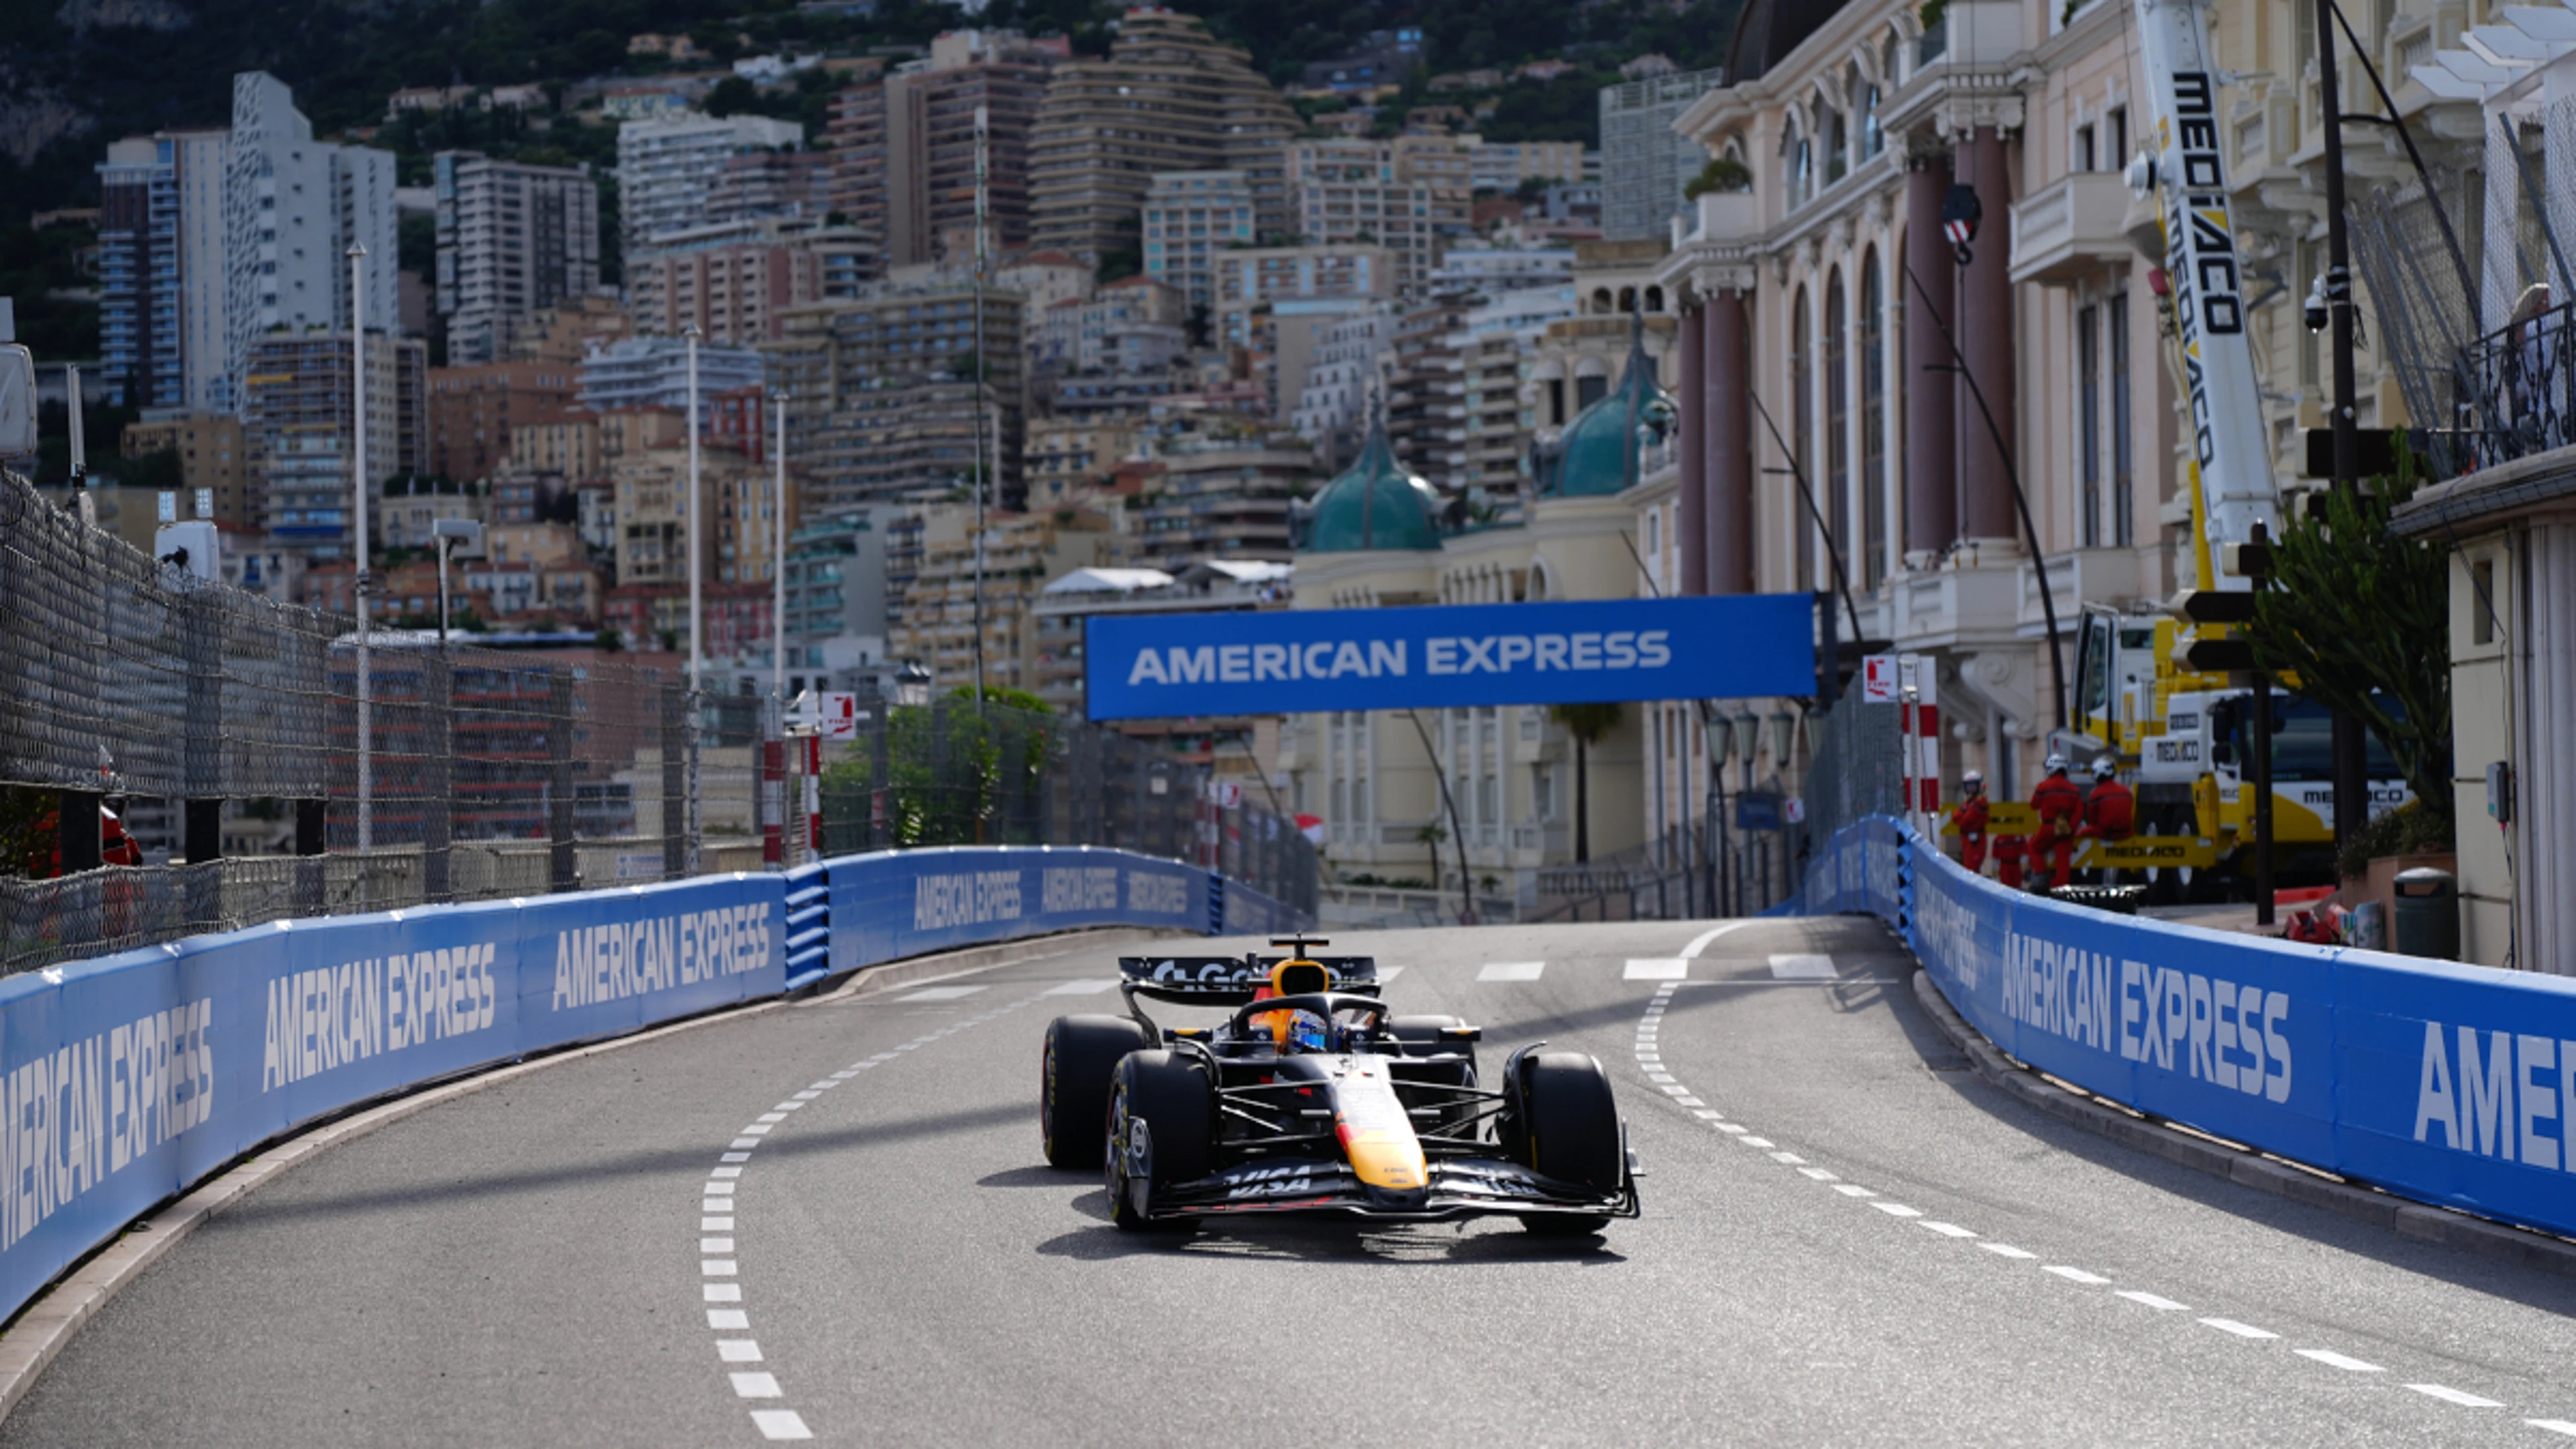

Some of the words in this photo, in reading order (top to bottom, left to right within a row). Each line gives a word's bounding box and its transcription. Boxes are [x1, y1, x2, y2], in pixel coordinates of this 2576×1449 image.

[1128, 639, 1407, 686] AMERICAN
[1426, 631, 1672, 675] EXPRESS
[263, 957, 381, 1093] AMERICAN
[388, 943, 495, 1051] EXPRESS
[552, 916, 675, 1012] AMERICAN
[680, 902, 769, 985] EXPRESS
[2002, 930, 2111, 1052] AMERICAN
[2121, 959, 2292, 1104] EXPRESS
[111, 998, 213, 1173] EXPRESS
